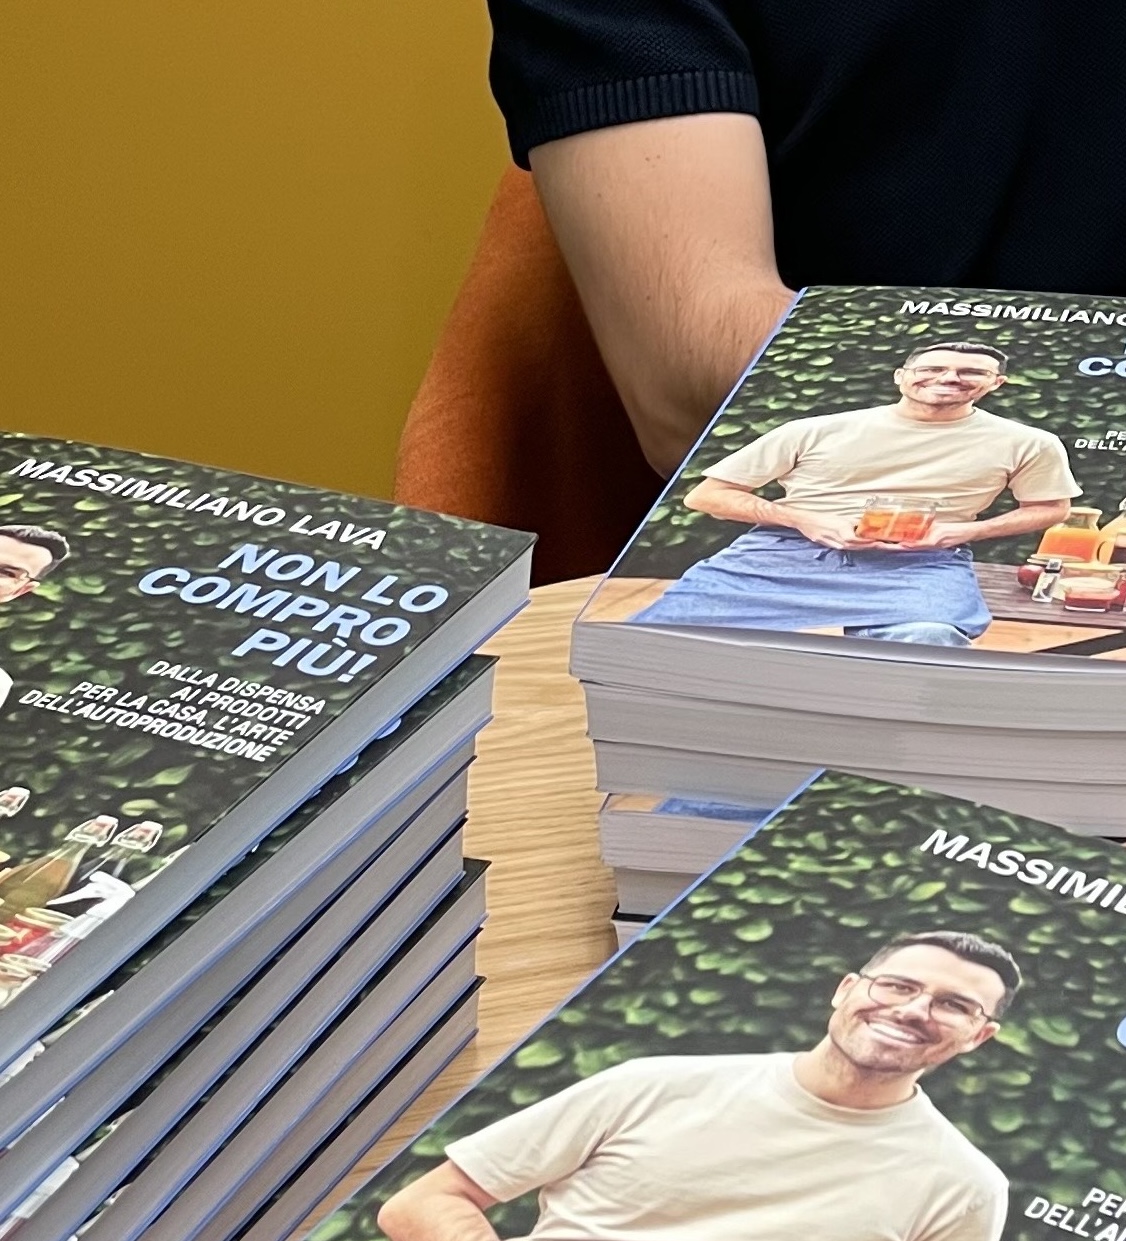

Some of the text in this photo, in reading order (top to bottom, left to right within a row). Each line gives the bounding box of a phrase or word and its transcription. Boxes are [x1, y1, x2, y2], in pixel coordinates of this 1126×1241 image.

[8, 458, 388, 551] MASSIMILIANO LAVA
[137, 567, 412, 646] COMPRO
[218, 543, 450, 613] NON LO
[146, 660, 326, 715] DALLA DISPENSA
[231, 628, 378, 683] PIÙ!
[18, 689, 277, 763] DELL'AUTOPRODUZIONE
[70, 681, 295, 746] PER LA CASA, L'ARTE
[170, 686, 311, 730] AI PRODOTTI
